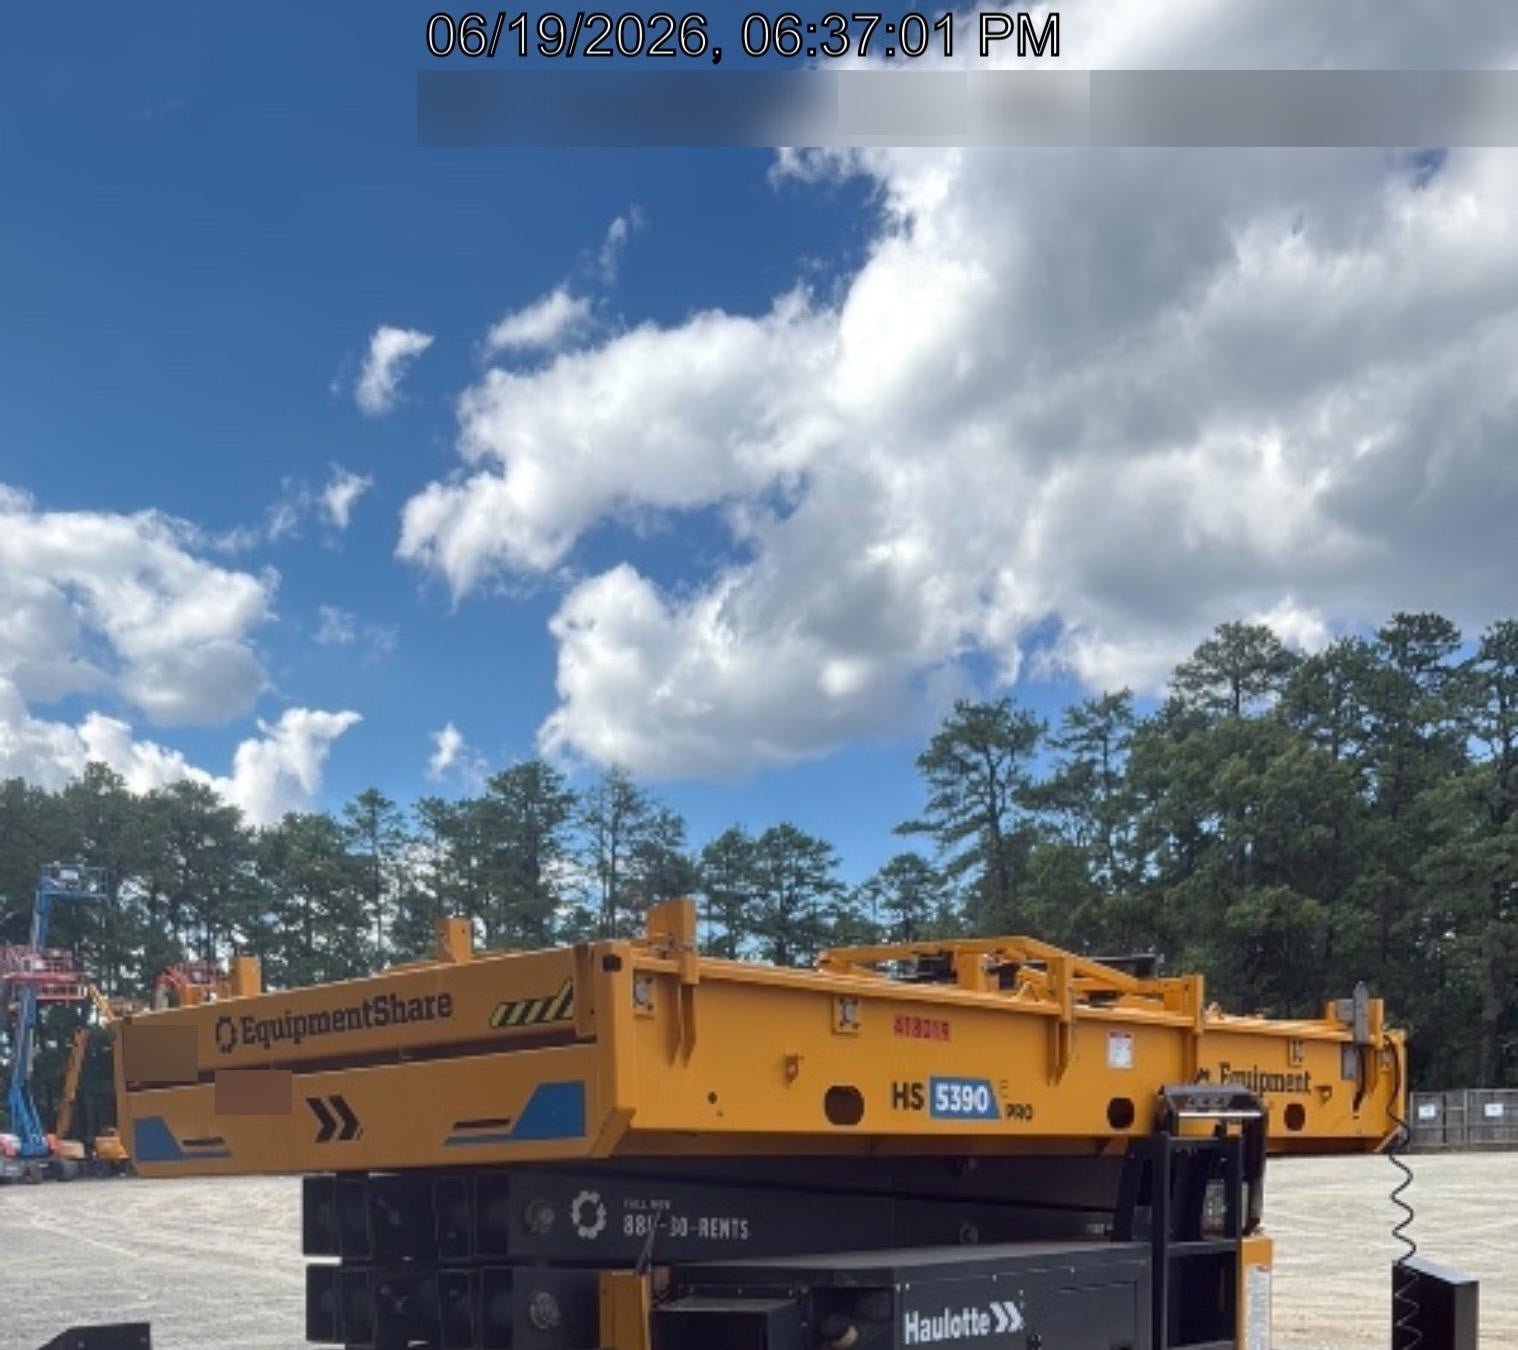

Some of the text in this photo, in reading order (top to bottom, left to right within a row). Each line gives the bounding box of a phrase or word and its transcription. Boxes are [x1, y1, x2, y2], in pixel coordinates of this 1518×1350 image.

[240, 992, 452, 1048] EquipmentShare
[892, 1081, 925, 1111] HS
[935, 1082, 989, 1114] 5390
[1006, 1102, 1034, 1121] PRO
[904, 1307, 991, 1345] Haulotte
